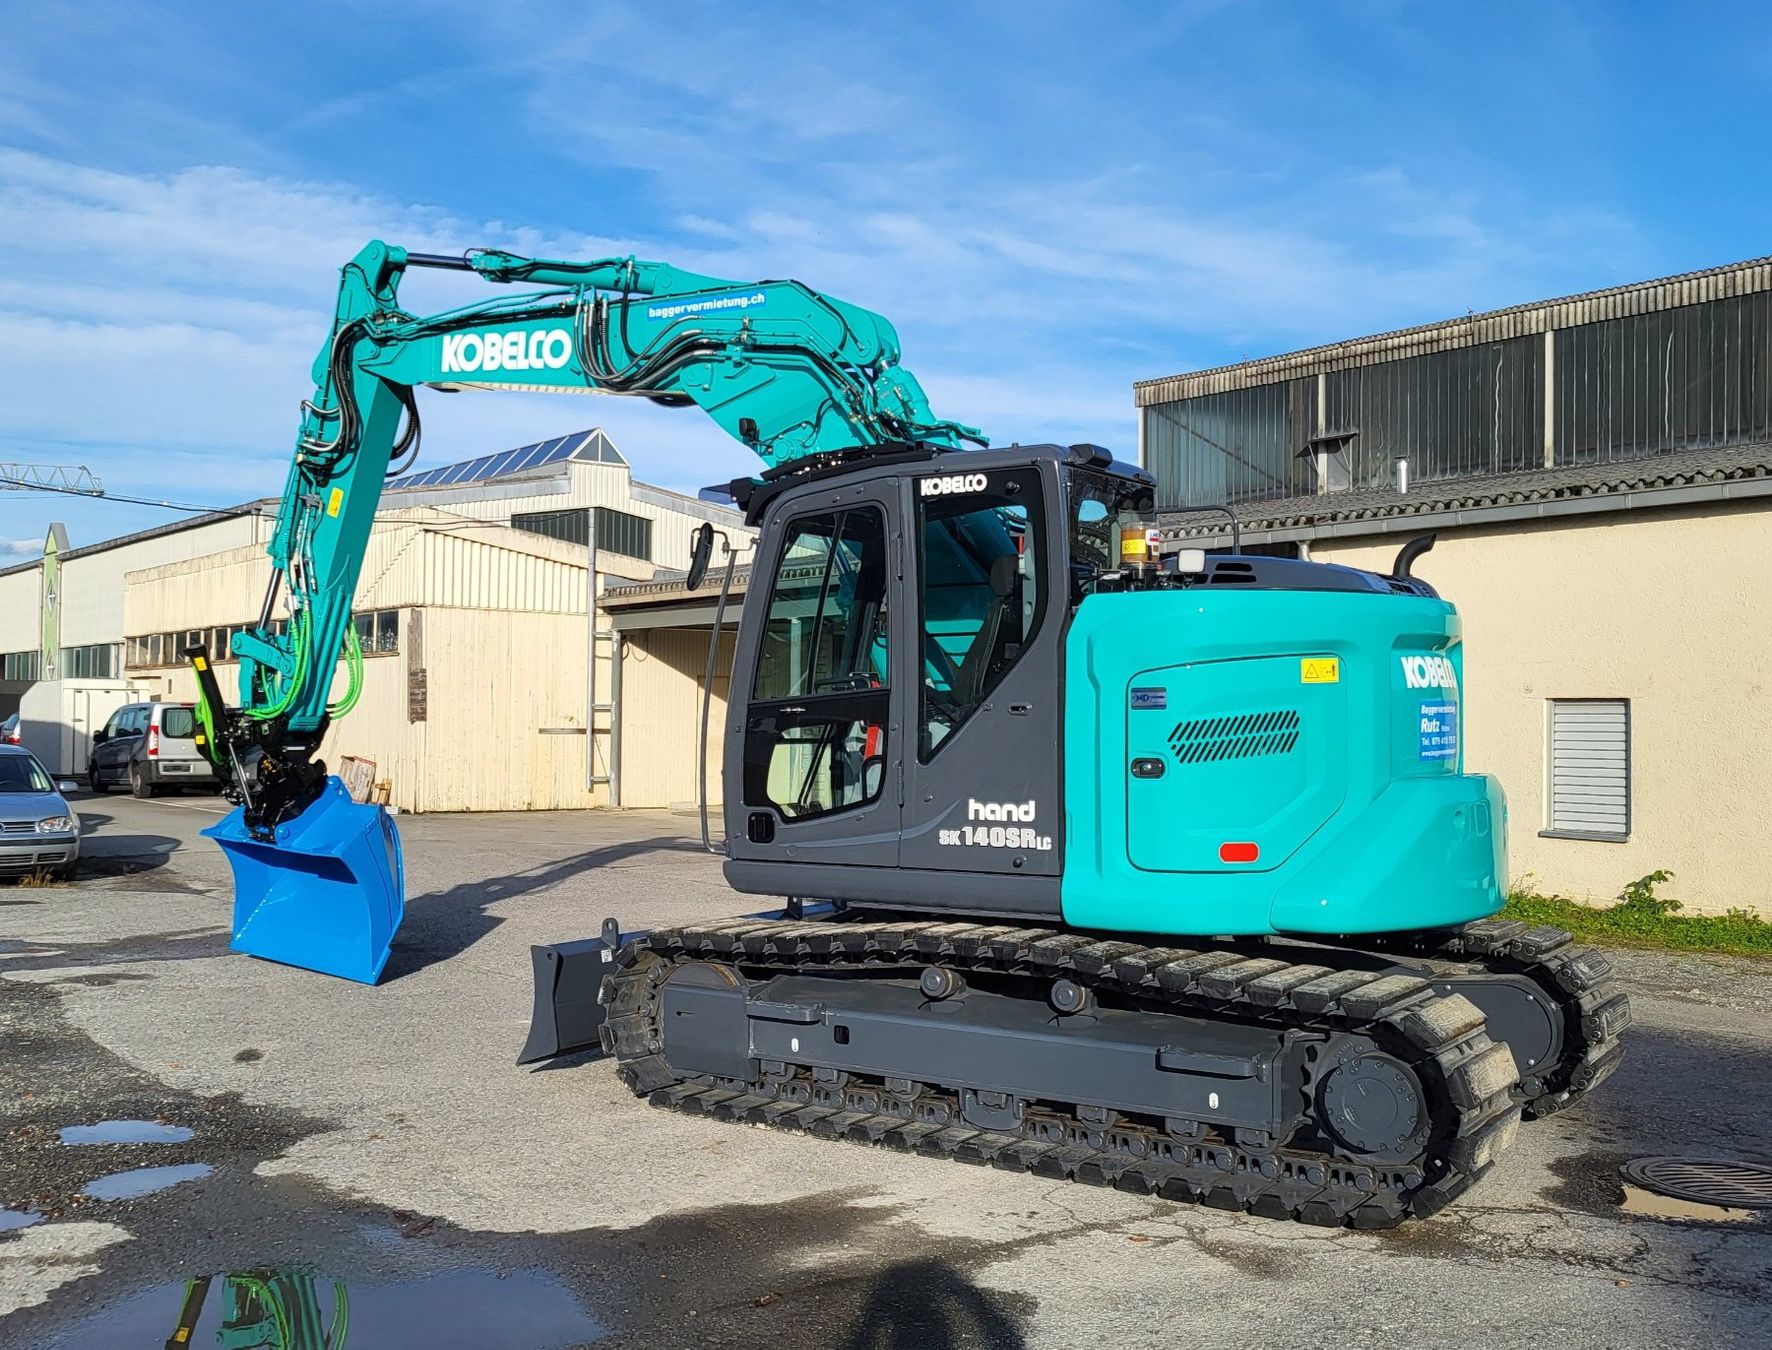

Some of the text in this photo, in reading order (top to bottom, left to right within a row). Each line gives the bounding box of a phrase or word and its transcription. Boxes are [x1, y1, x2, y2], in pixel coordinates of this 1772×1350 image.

[648, 293, 766, 319] baggervermietung.ch
[441, 328, 573, 373] KOBELCO
[920, 473, 988, 497] KOBELCO
[1420, 717, 1440, 733] Rutz
[968, 798, 1036, 822] hand
